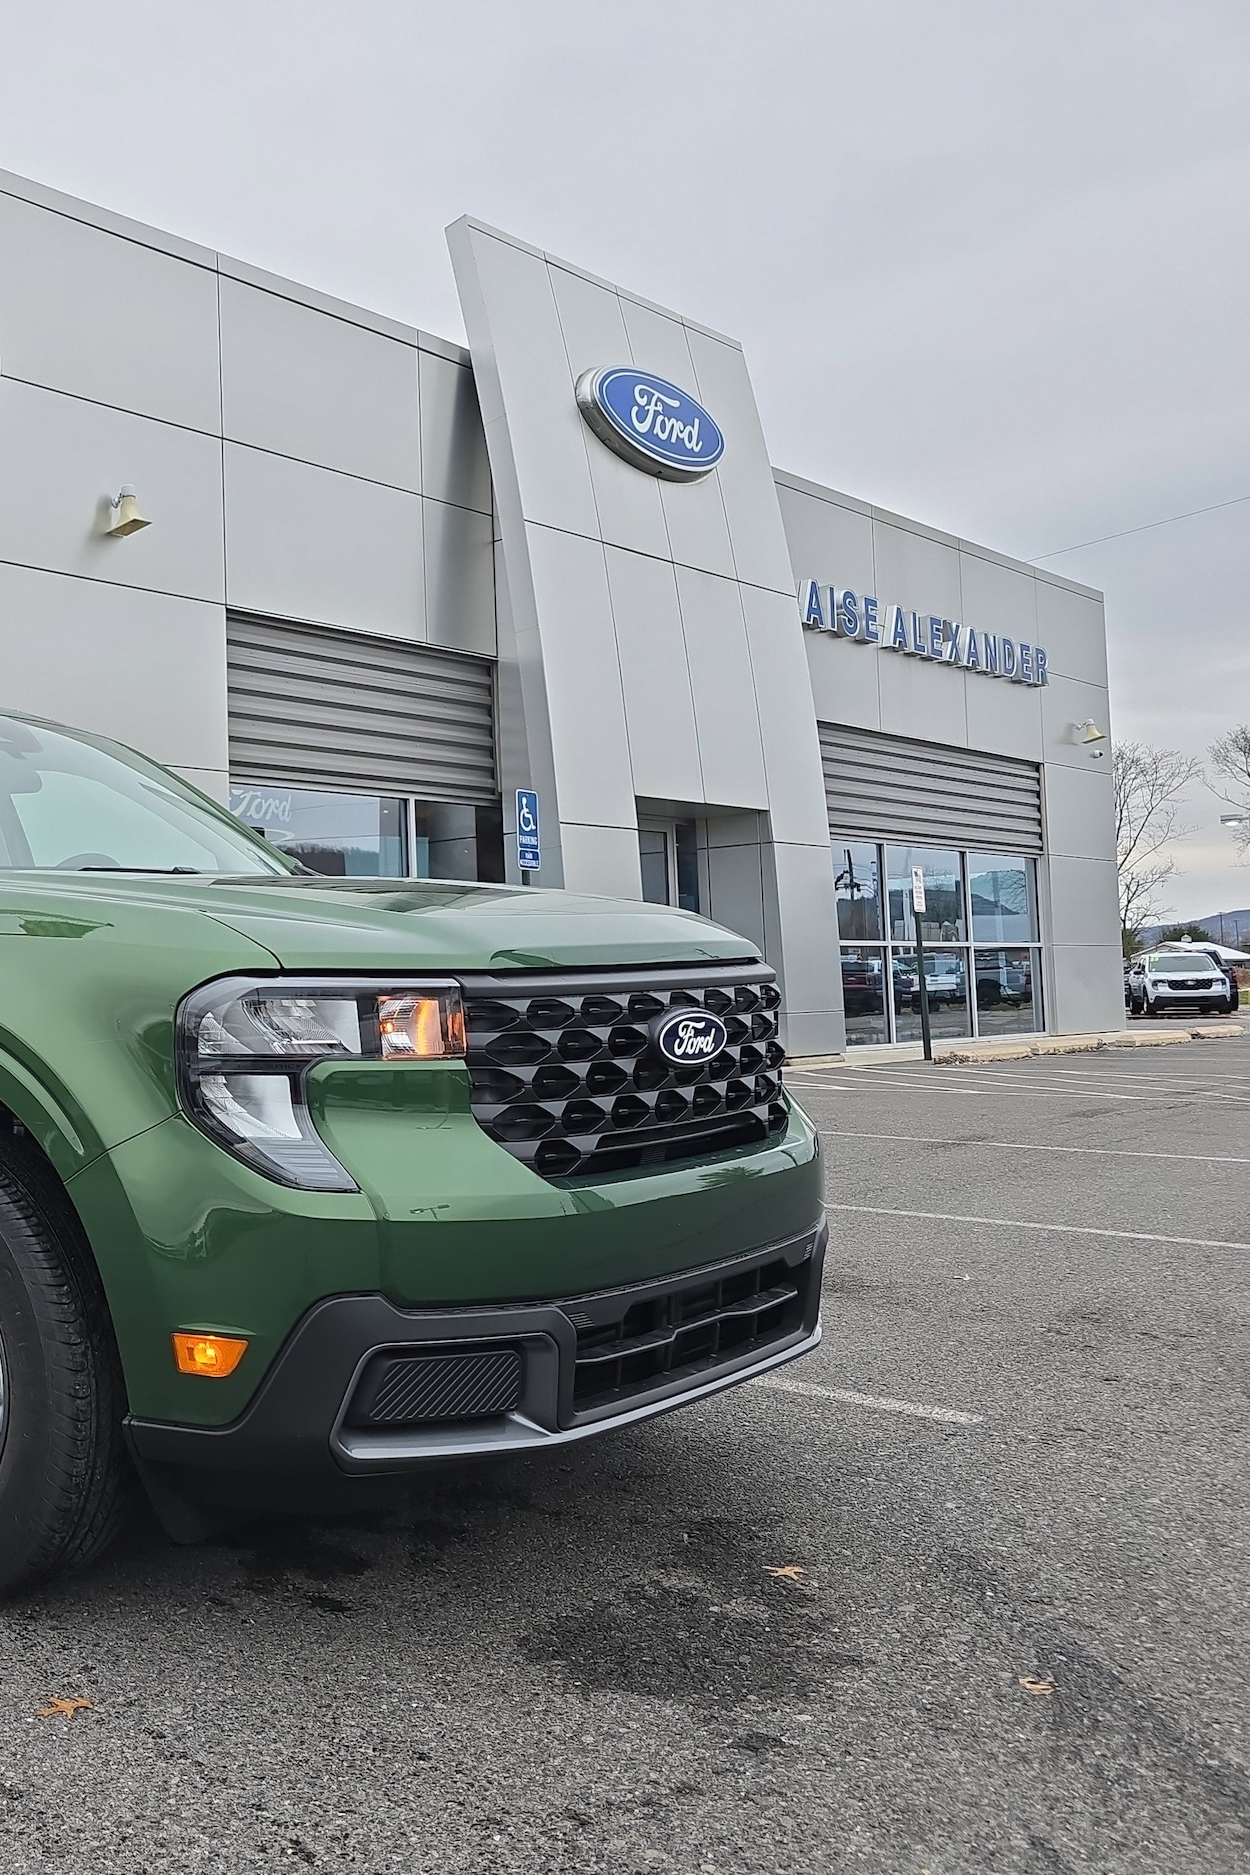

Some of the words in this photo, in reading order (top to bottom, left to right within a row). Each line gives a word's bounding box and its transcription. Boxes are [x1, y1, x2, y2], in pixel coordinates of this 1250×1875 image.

[630, 383, 704, 453] Ford
[888, 604, 1049, 687] ALEXANDER
[673, 1020, 716, 1056] Ford
